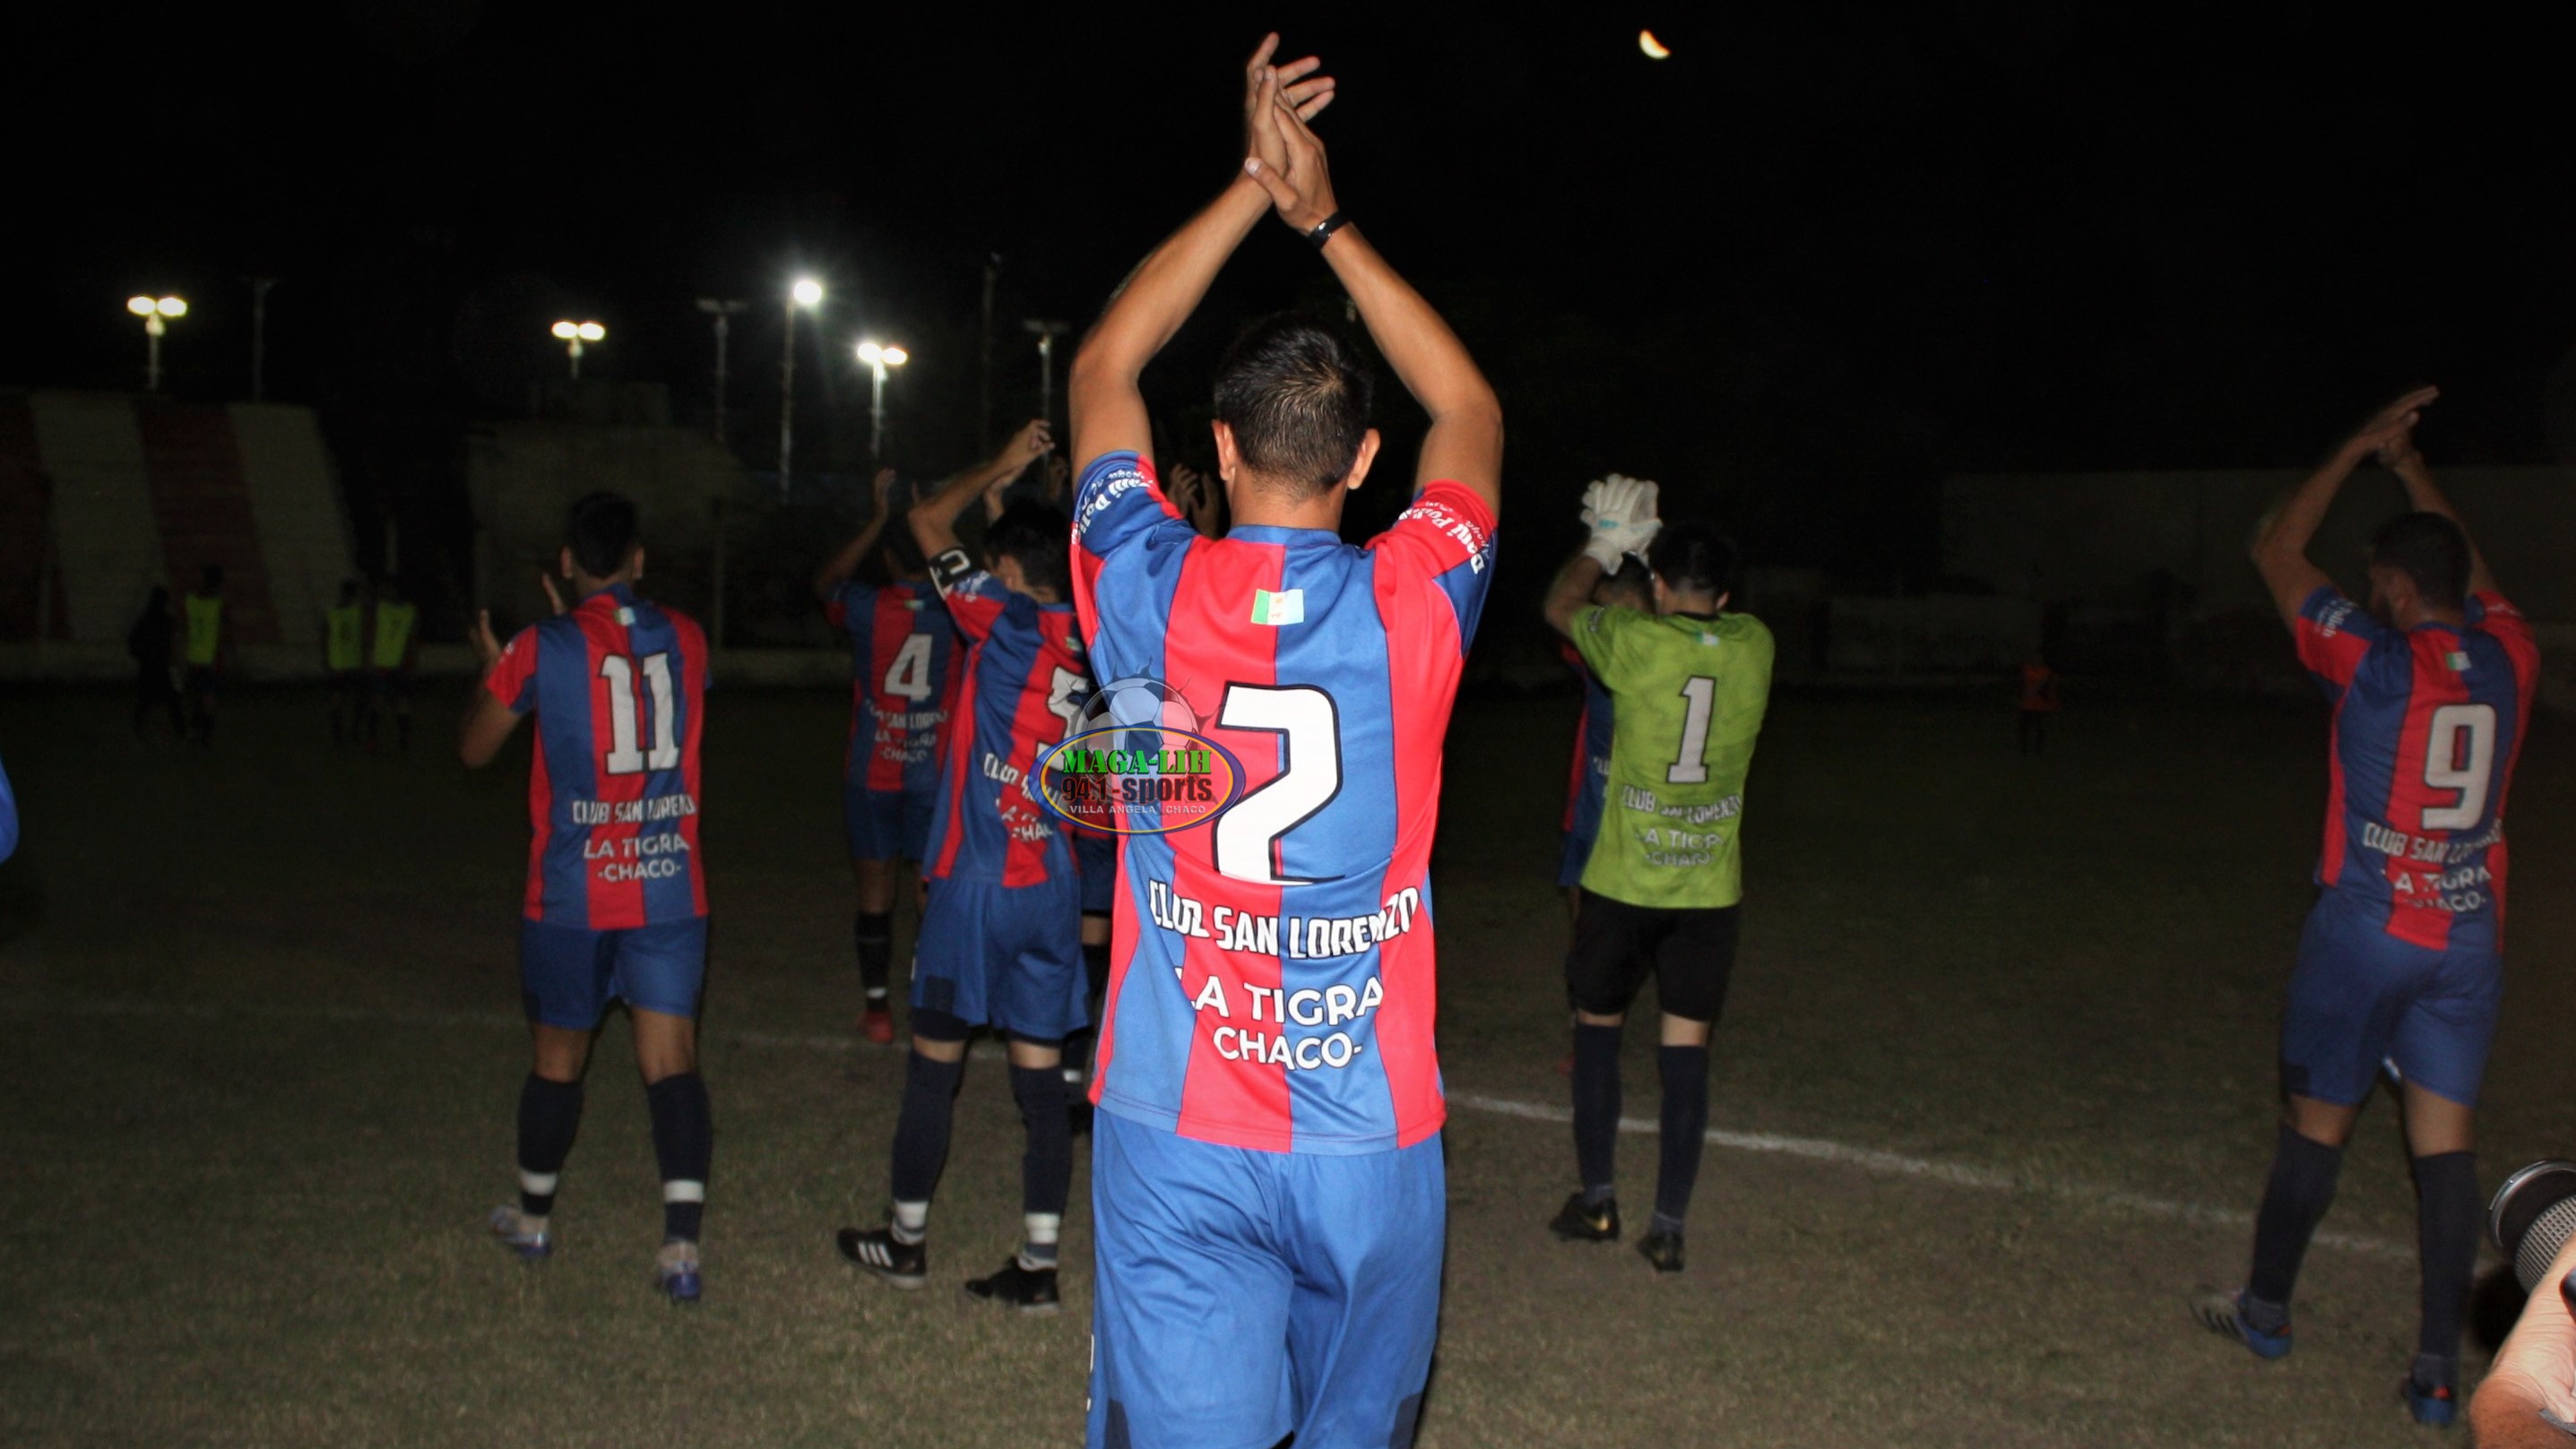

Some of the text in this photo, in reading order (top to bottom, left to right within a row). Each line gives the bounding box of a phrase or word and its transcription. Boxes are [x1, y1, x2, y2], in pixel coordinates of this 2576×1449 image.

[883, 633, 934, 703] 4
[599, 650, 681, 775] 11
[1035, 664, 1091, 772] 5
[1667, 674, 1716, 784] 1
[1212, 680, 1344, 885] 2
[2422, 703, 2497, 832] 9
[572, 799, 610, 824] CLUB
[614, 798, 643, 824] SAN
[583, 832, 690, 859] LA TIGRA
[2362, 822, 2409, 857] CLUB
[2409, 836, 2451, 863] SAN
[1214, 905, 1280, 956] SAN
[1287, 886, 1420, 959] LORENZO
[1243, 975, 1385, 1026] TIGRA
